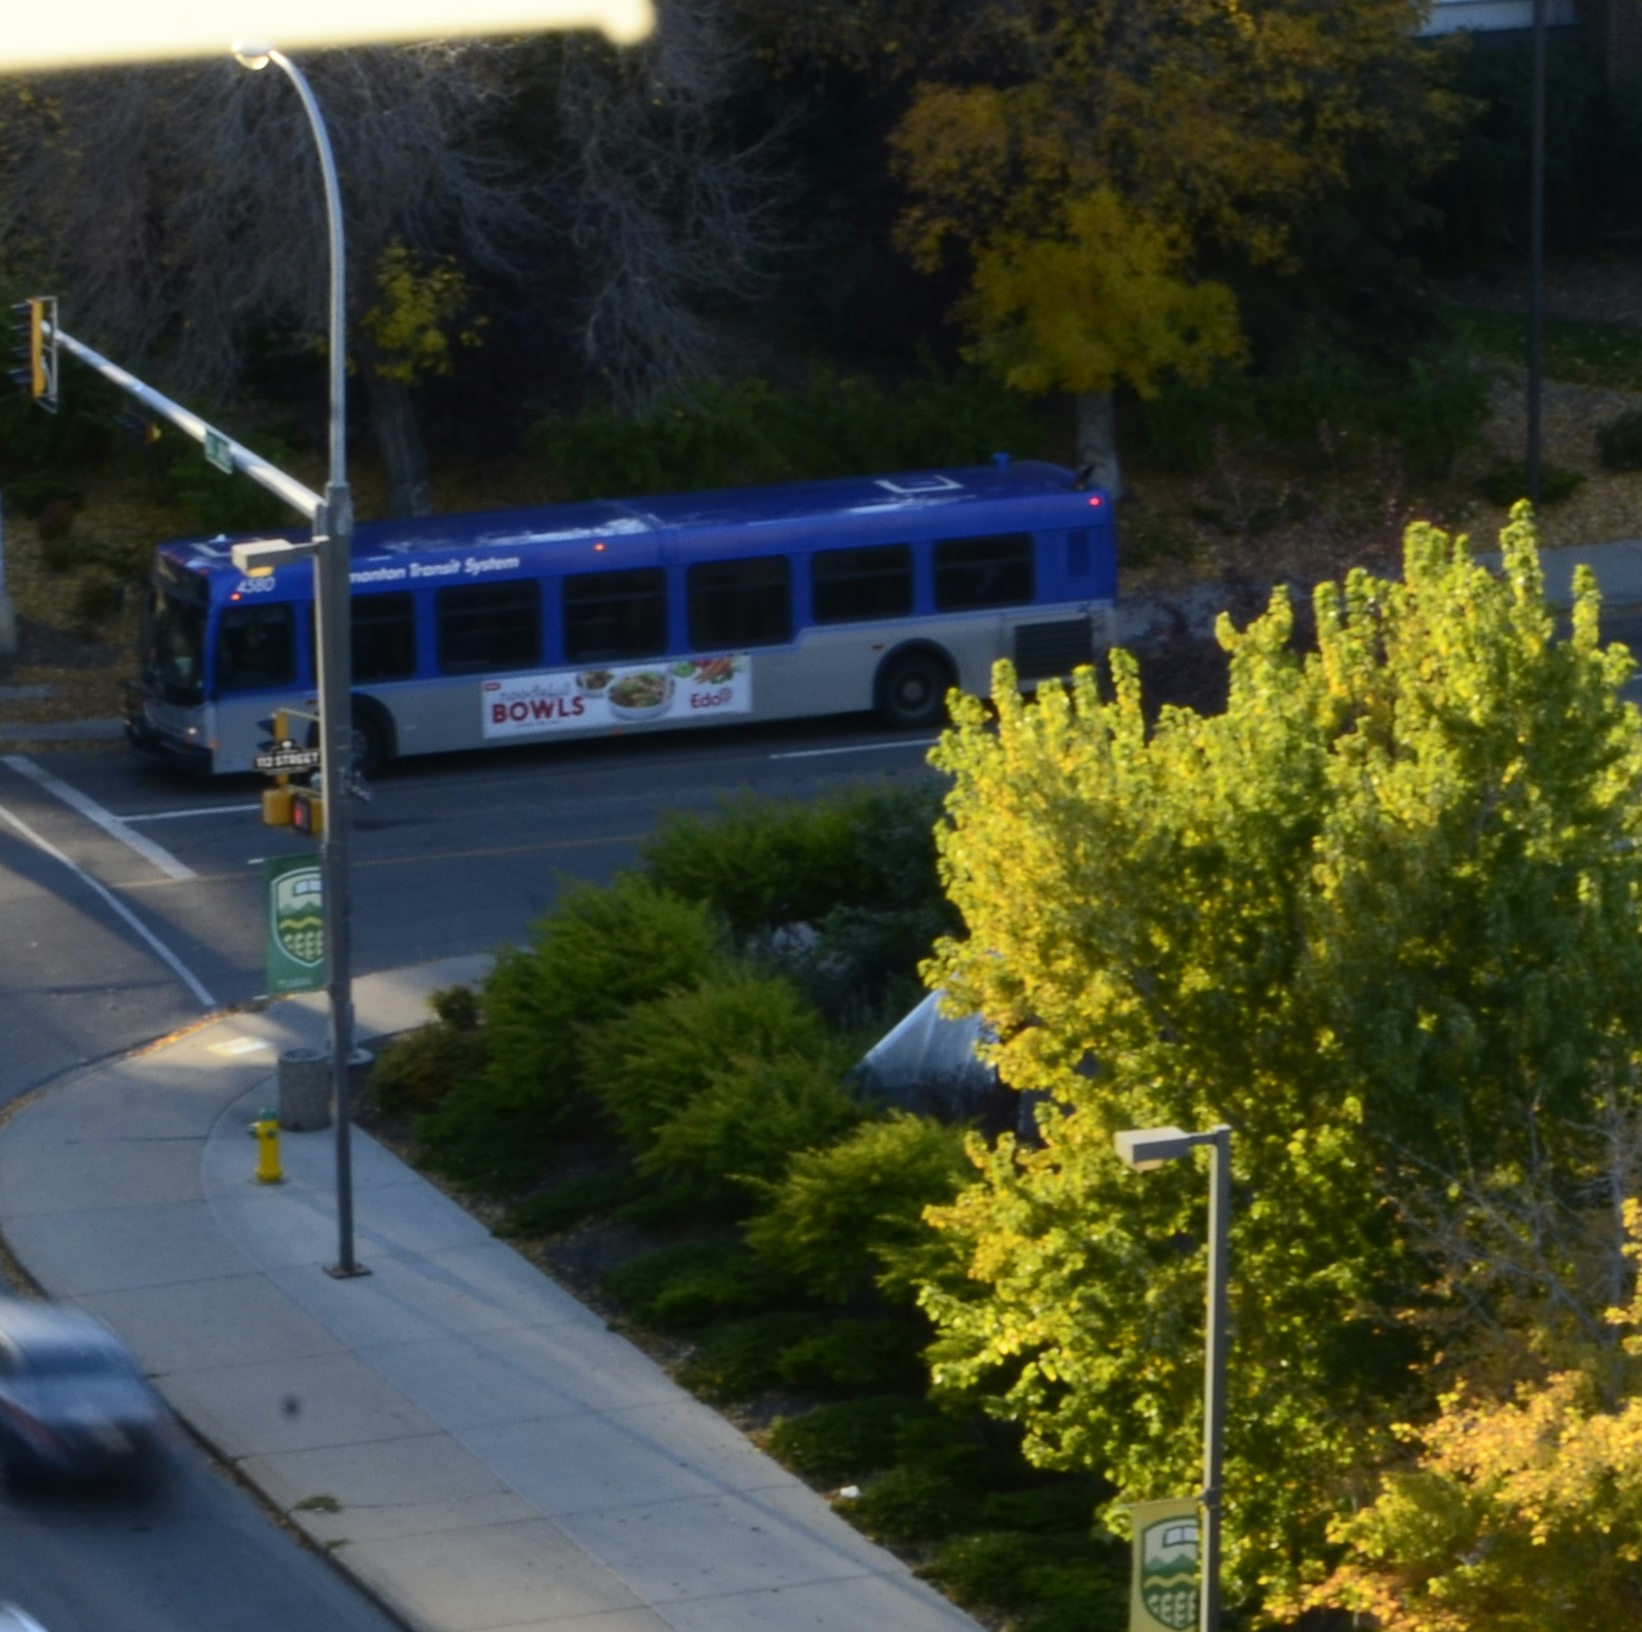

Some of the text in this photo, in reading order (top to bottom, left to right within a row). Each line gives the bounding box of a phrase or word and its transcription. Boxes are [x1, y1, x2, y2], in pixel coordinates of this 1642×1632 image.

[349, 556, 521, 583] monton Transit System
[492, 695, 585, 724] BOWLS
[690, 691, 721, 710] Edo
[275, 752, 319, 767] STREET
